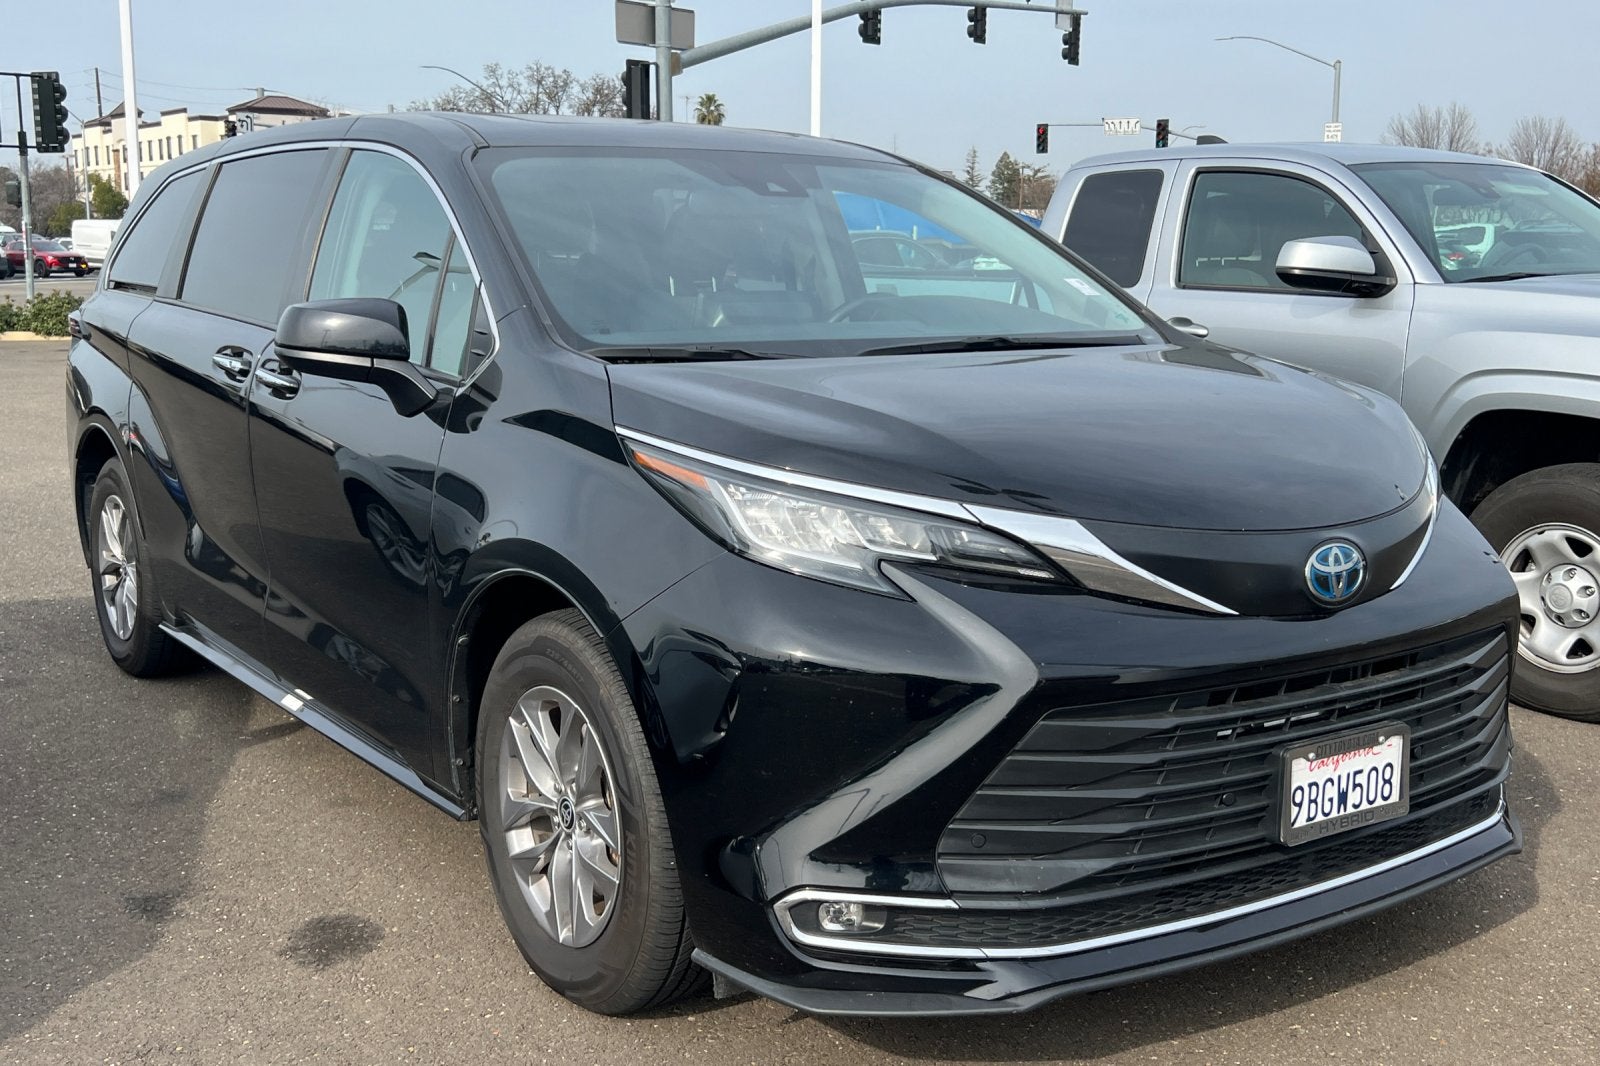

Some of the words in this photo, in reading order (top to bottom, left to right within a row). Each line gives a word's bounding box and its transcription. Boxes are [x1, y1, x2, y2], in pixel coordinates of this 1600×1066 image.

[1308, 747, 1381, 772] California
[1291, 762, 1394, 827] 9BGW508
[1320, 810, 1375, 834] HYBRID
